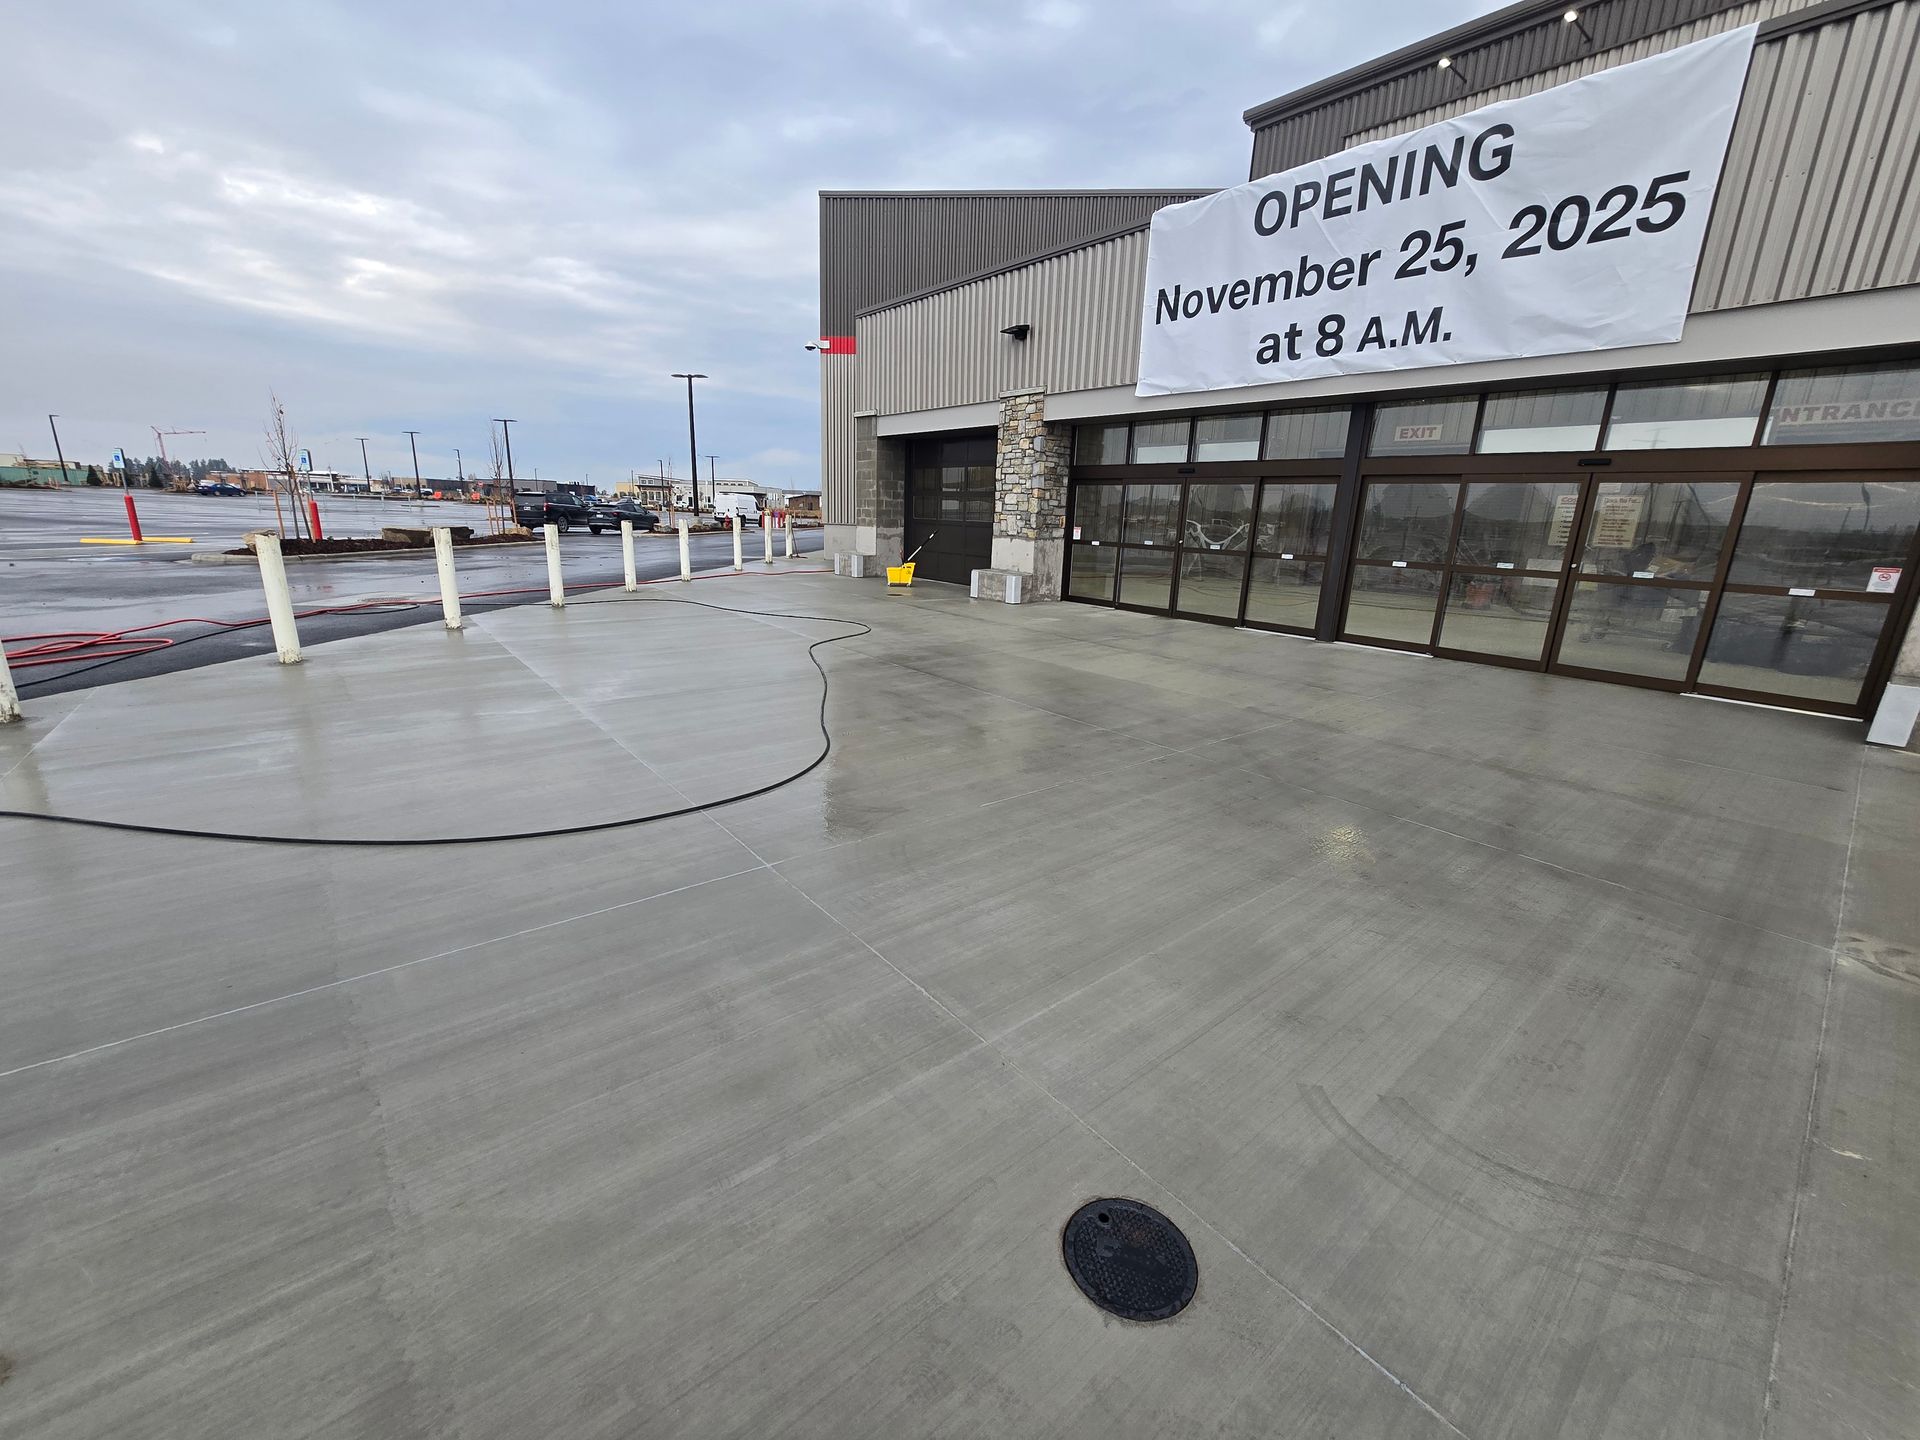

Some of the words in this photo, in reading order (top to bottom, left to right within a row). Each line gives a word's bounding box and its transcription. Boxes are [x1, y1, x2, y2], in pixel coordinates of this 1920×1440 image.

[1254, 123, 1515, 237] OPENING
[1155, 249, 1382, 326] November
[1393, 219, 1478, 280] 25,
[1502, 170, 1691, 260] 2025
[1256, 322, 1304, 365] at
[1315, 313, 1346, 358] 8
[1356, 306, 1453, 354] A.M.
[1399, 426, 1437, 439] EXIT
